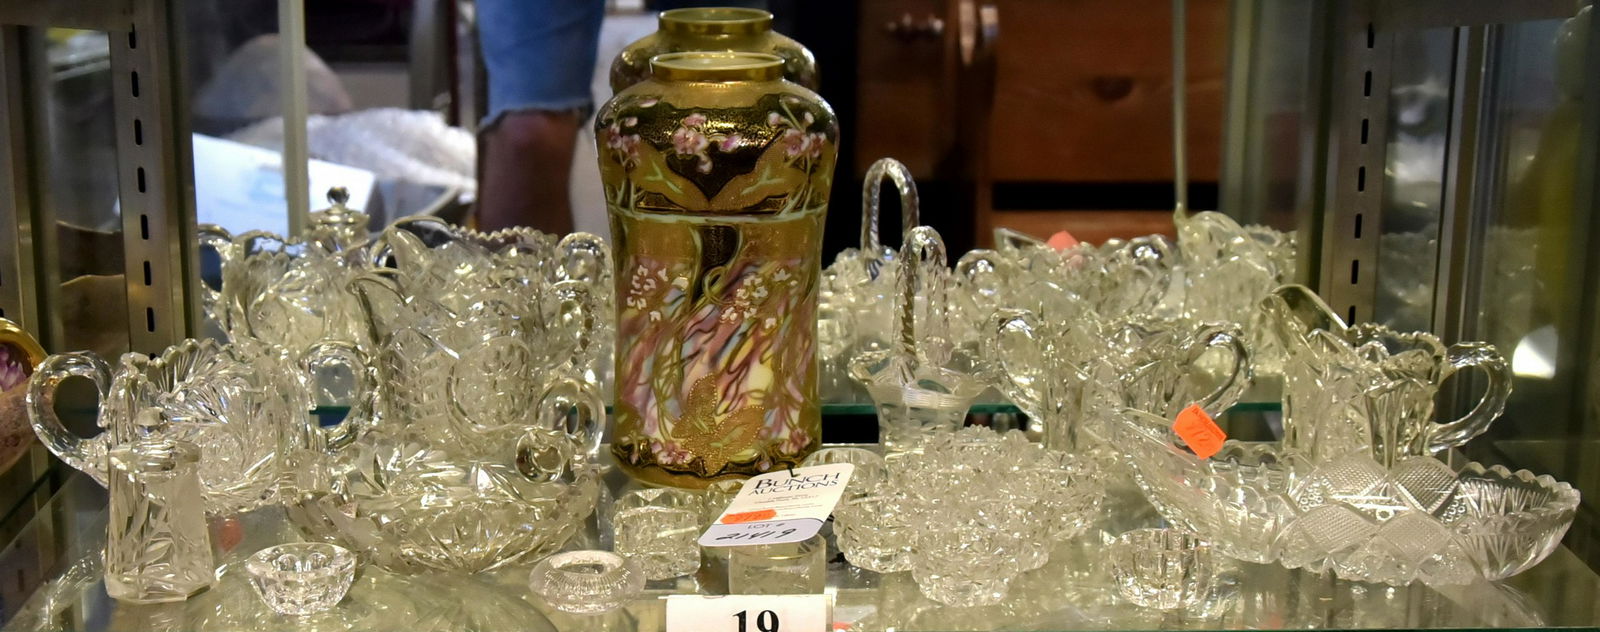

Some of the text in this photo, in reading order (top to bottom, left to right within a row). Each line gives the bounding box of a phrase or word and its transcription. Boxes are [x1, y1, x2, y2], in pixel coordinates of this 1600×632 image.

[748, 480, 838, 496] AUCTIONS
[754, 472, 840, 490] BUNCH
[732, 609, 780, 632] 19
